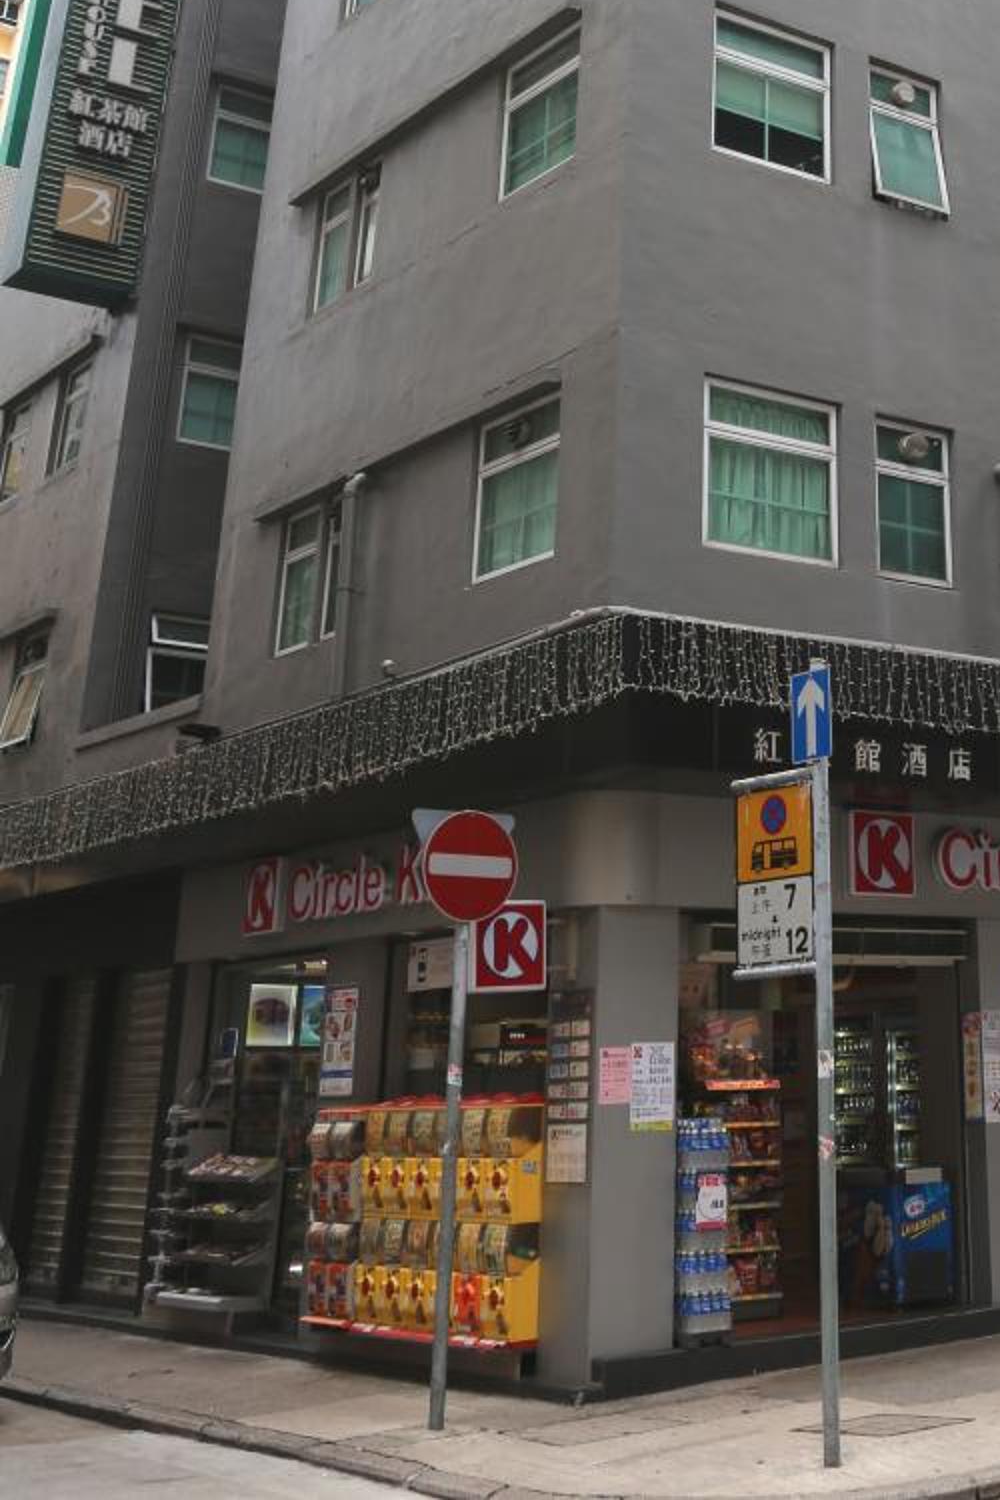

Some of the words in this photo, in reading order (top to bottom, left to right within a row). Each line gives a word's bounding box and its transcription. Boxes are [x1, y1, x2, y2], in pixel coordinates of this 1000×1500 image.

[68, 88, 149, 133] 紅茶館
[78, 118, 133, 158] 酒店
[290, 854, 386, 922] Circle
[784, 883, 797, 910] 7
[785, 926, 809, 955] 12
